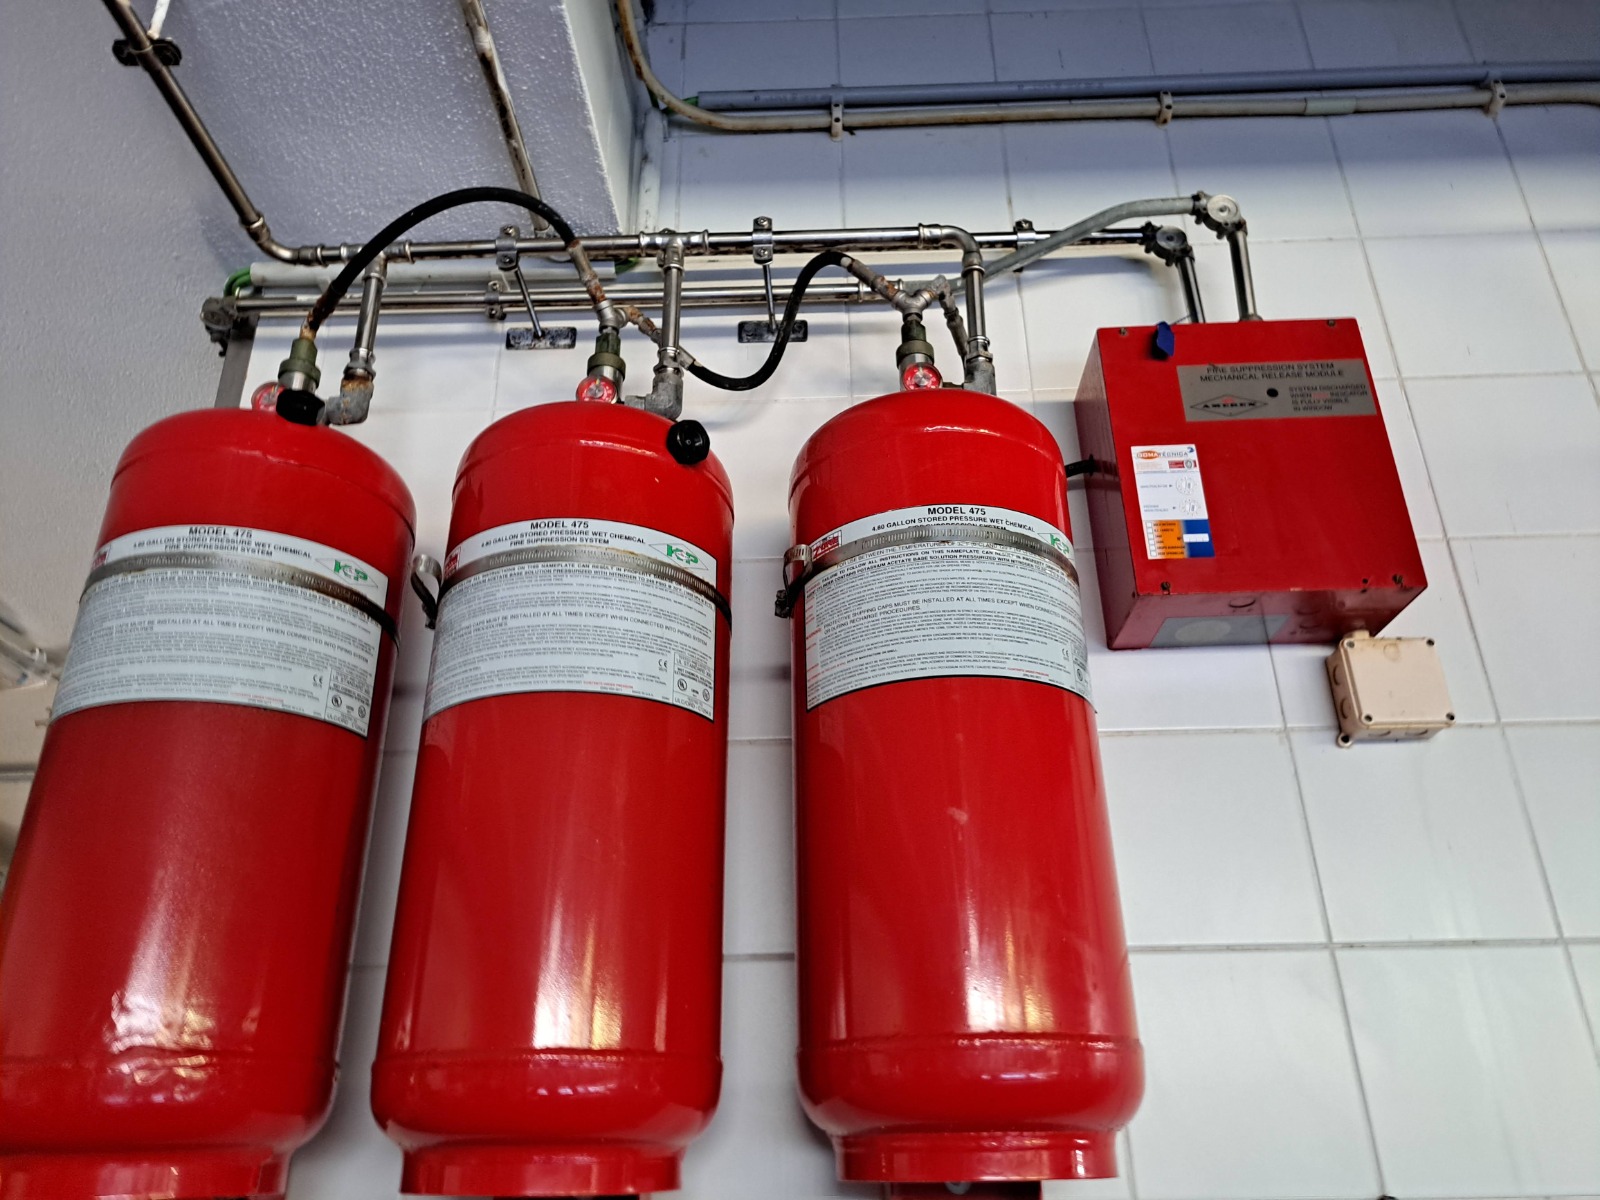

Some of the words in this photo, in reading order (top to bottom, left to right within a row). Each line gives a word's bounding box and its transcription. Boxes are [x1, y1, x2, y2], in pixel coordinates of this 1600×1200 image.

[1229, 364, 1294, 373] SUPPRESSION
[1297, 362, 1334, 370] SYSTEM
[1200, 373, 1258, 382] MECHANICAL
[1261, 371, 1303, 379] RELEASE
[1305, 369, 1344, 378] MODULE
[927, 506, 966, 515] MODEL
[968, 507, 986, 516] 475
[530, 520, 568, 530] MODEL
[570, 520, 589, 528] 475
[886, 518, 916, 528] GALLON
[917, 516, 948, 524] STORED
[1005, 519, 1035, 532] CHEMICAL
[188, 526, 228, 536] MODEL
[492, 533, 519, 545] GALLON
[520, 530, 548, 539] STORED
[609, 532, 646, 544] CHEMICAL
[526, 536, 578, 544] SUPPRESSION
[579, 537, 610, 545] SYSTEM
[146, 537, 175, 546] GALLON
[209, 537, 252, 546] PRESSURE
[254, 542, 271, 550] WET
[273, 544, 312, 558] CHEMICAL
[183, 543, 238, 552] SUPPRESSION
[240, 548, 273, 557] SYSTEM
[846, 562, 866, 572] FOLLOW
[879, 551, 919, 562] INSTRUCTIONS
[886, 558, 911, 566] ACETATE
[877, 602, 893, 610] CAPS
[893, 600, 910, 608] MUST
[996, 598, 1018, 606] EXCEPT
[1019, 602, 1035, 610] WHEN
